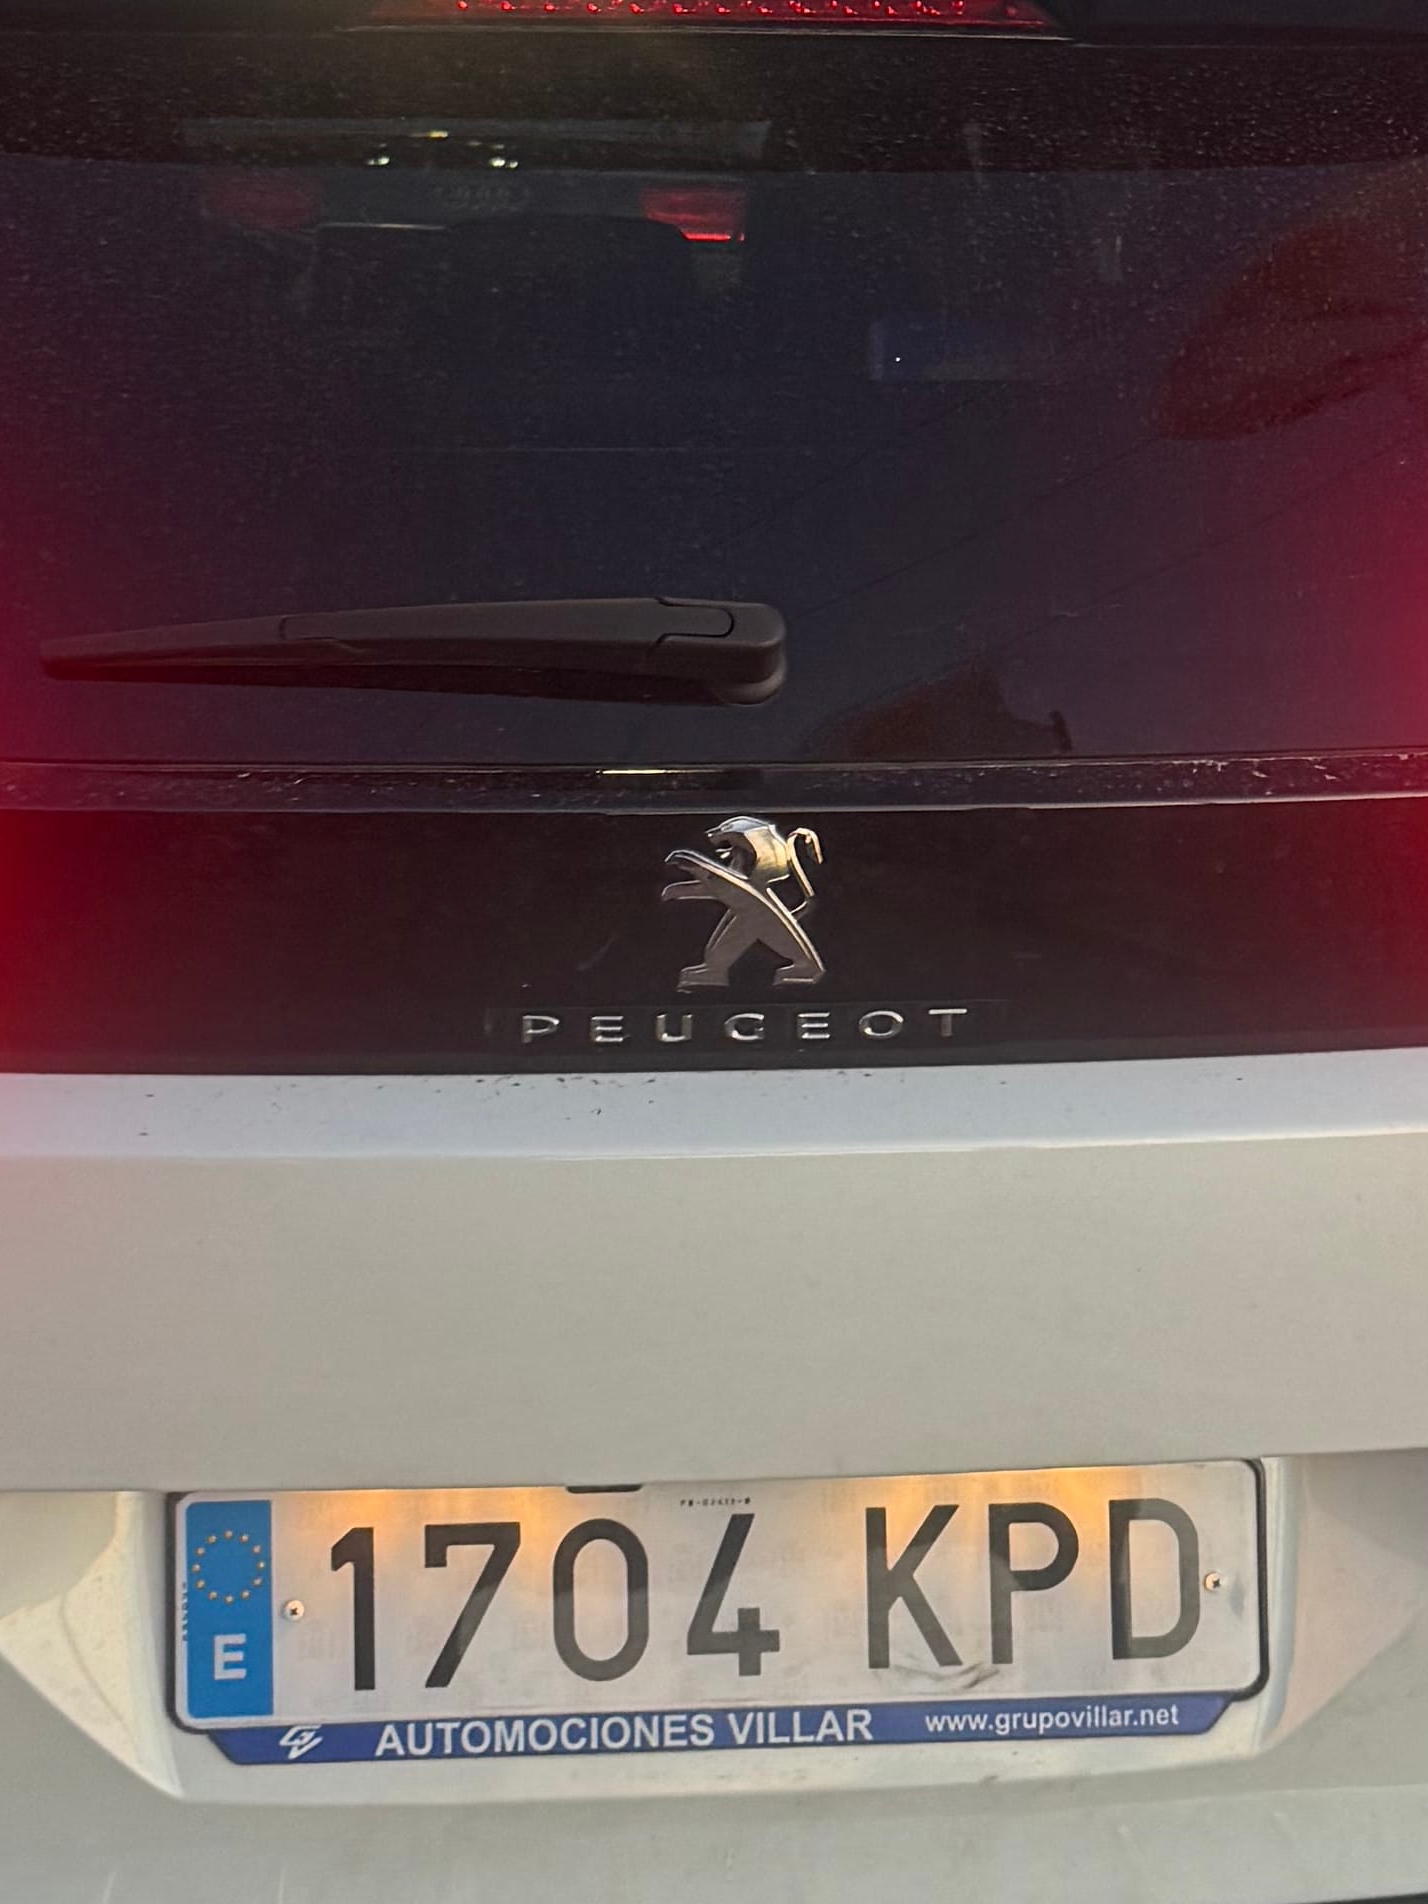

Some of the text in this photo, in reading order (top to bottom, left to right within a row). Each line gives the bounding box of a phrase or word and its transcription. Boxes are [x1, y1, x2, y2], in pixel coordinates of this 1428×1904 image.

[522, 1007, 968, 1044] PEUGEOT
[329, 1497, 1201, 1691] 1704 KPD
[212, 1633, 247, 1681] E
[374, 1708, 874, 1758] AUTOMOCIONES VILLAR
[924, 1704, 1180, 1736] www.grupovillar.net
